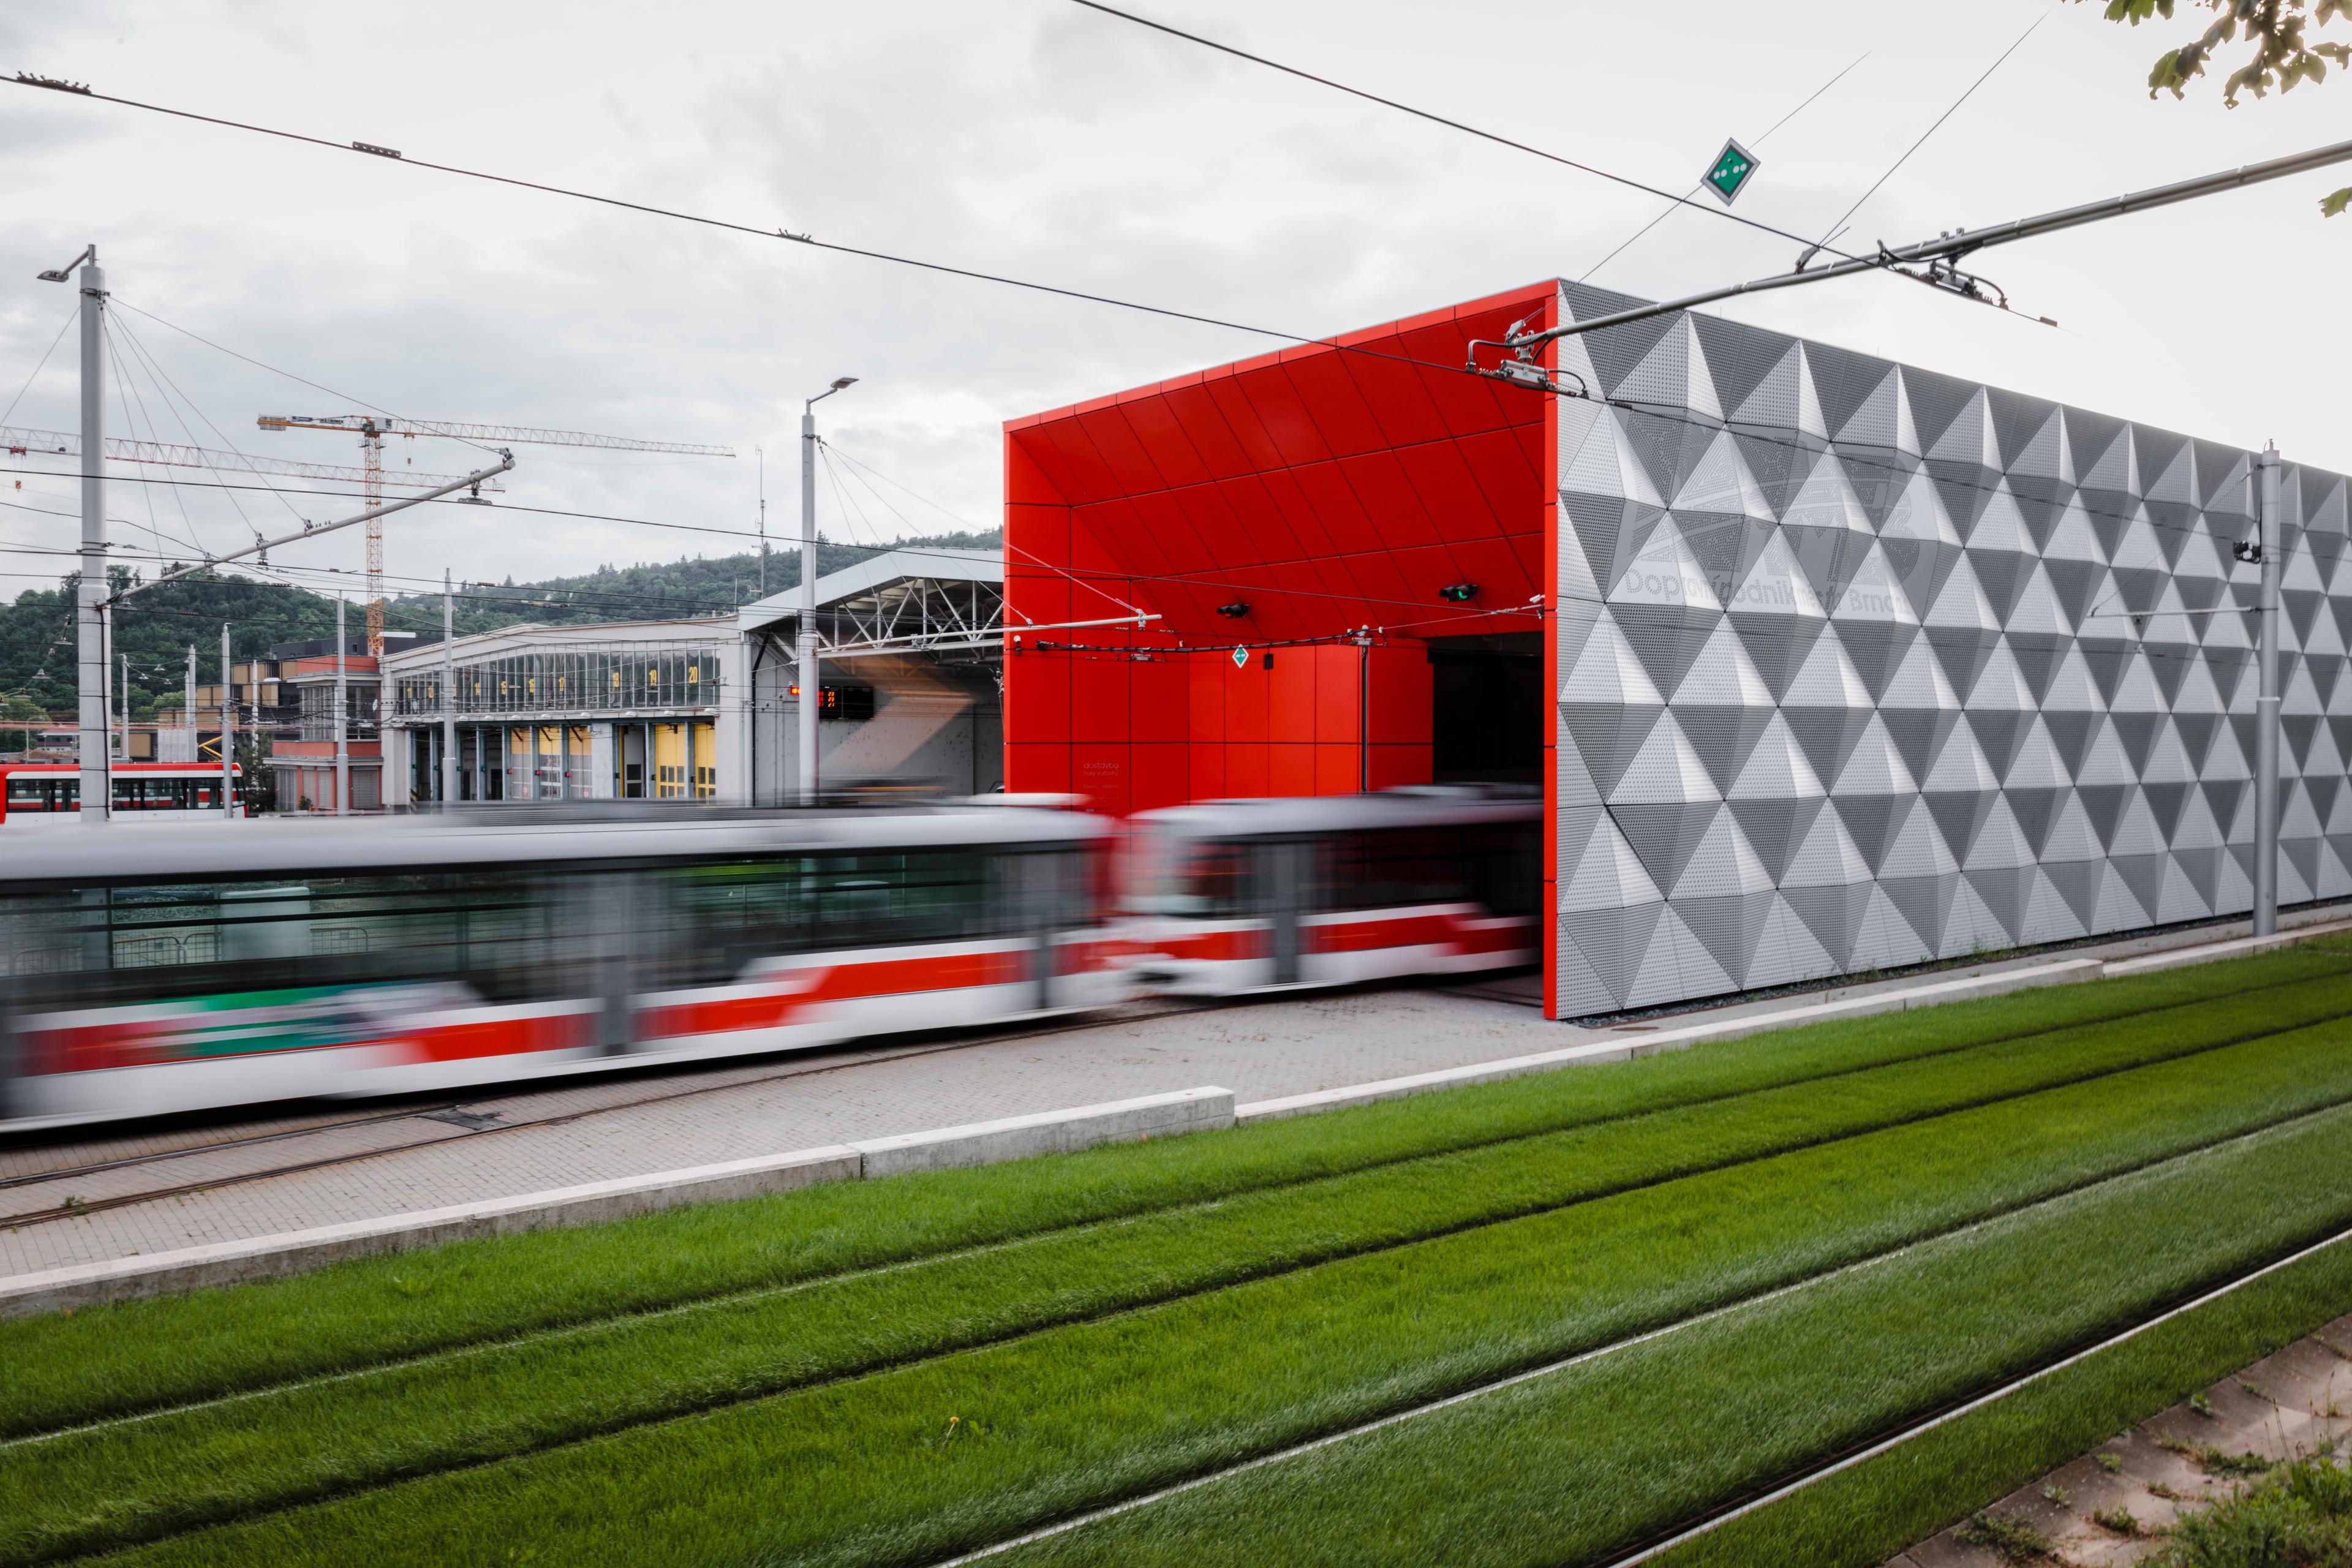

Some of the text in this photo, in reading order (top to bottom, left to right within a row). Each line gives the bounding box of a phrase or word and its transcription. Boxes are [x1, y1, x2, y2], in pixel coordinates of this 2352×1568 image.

[1625, 567, 1721, 602] Dopravní
[1717, 578, 1795, 606] podnik
[688, 666, 698, 684] 20
